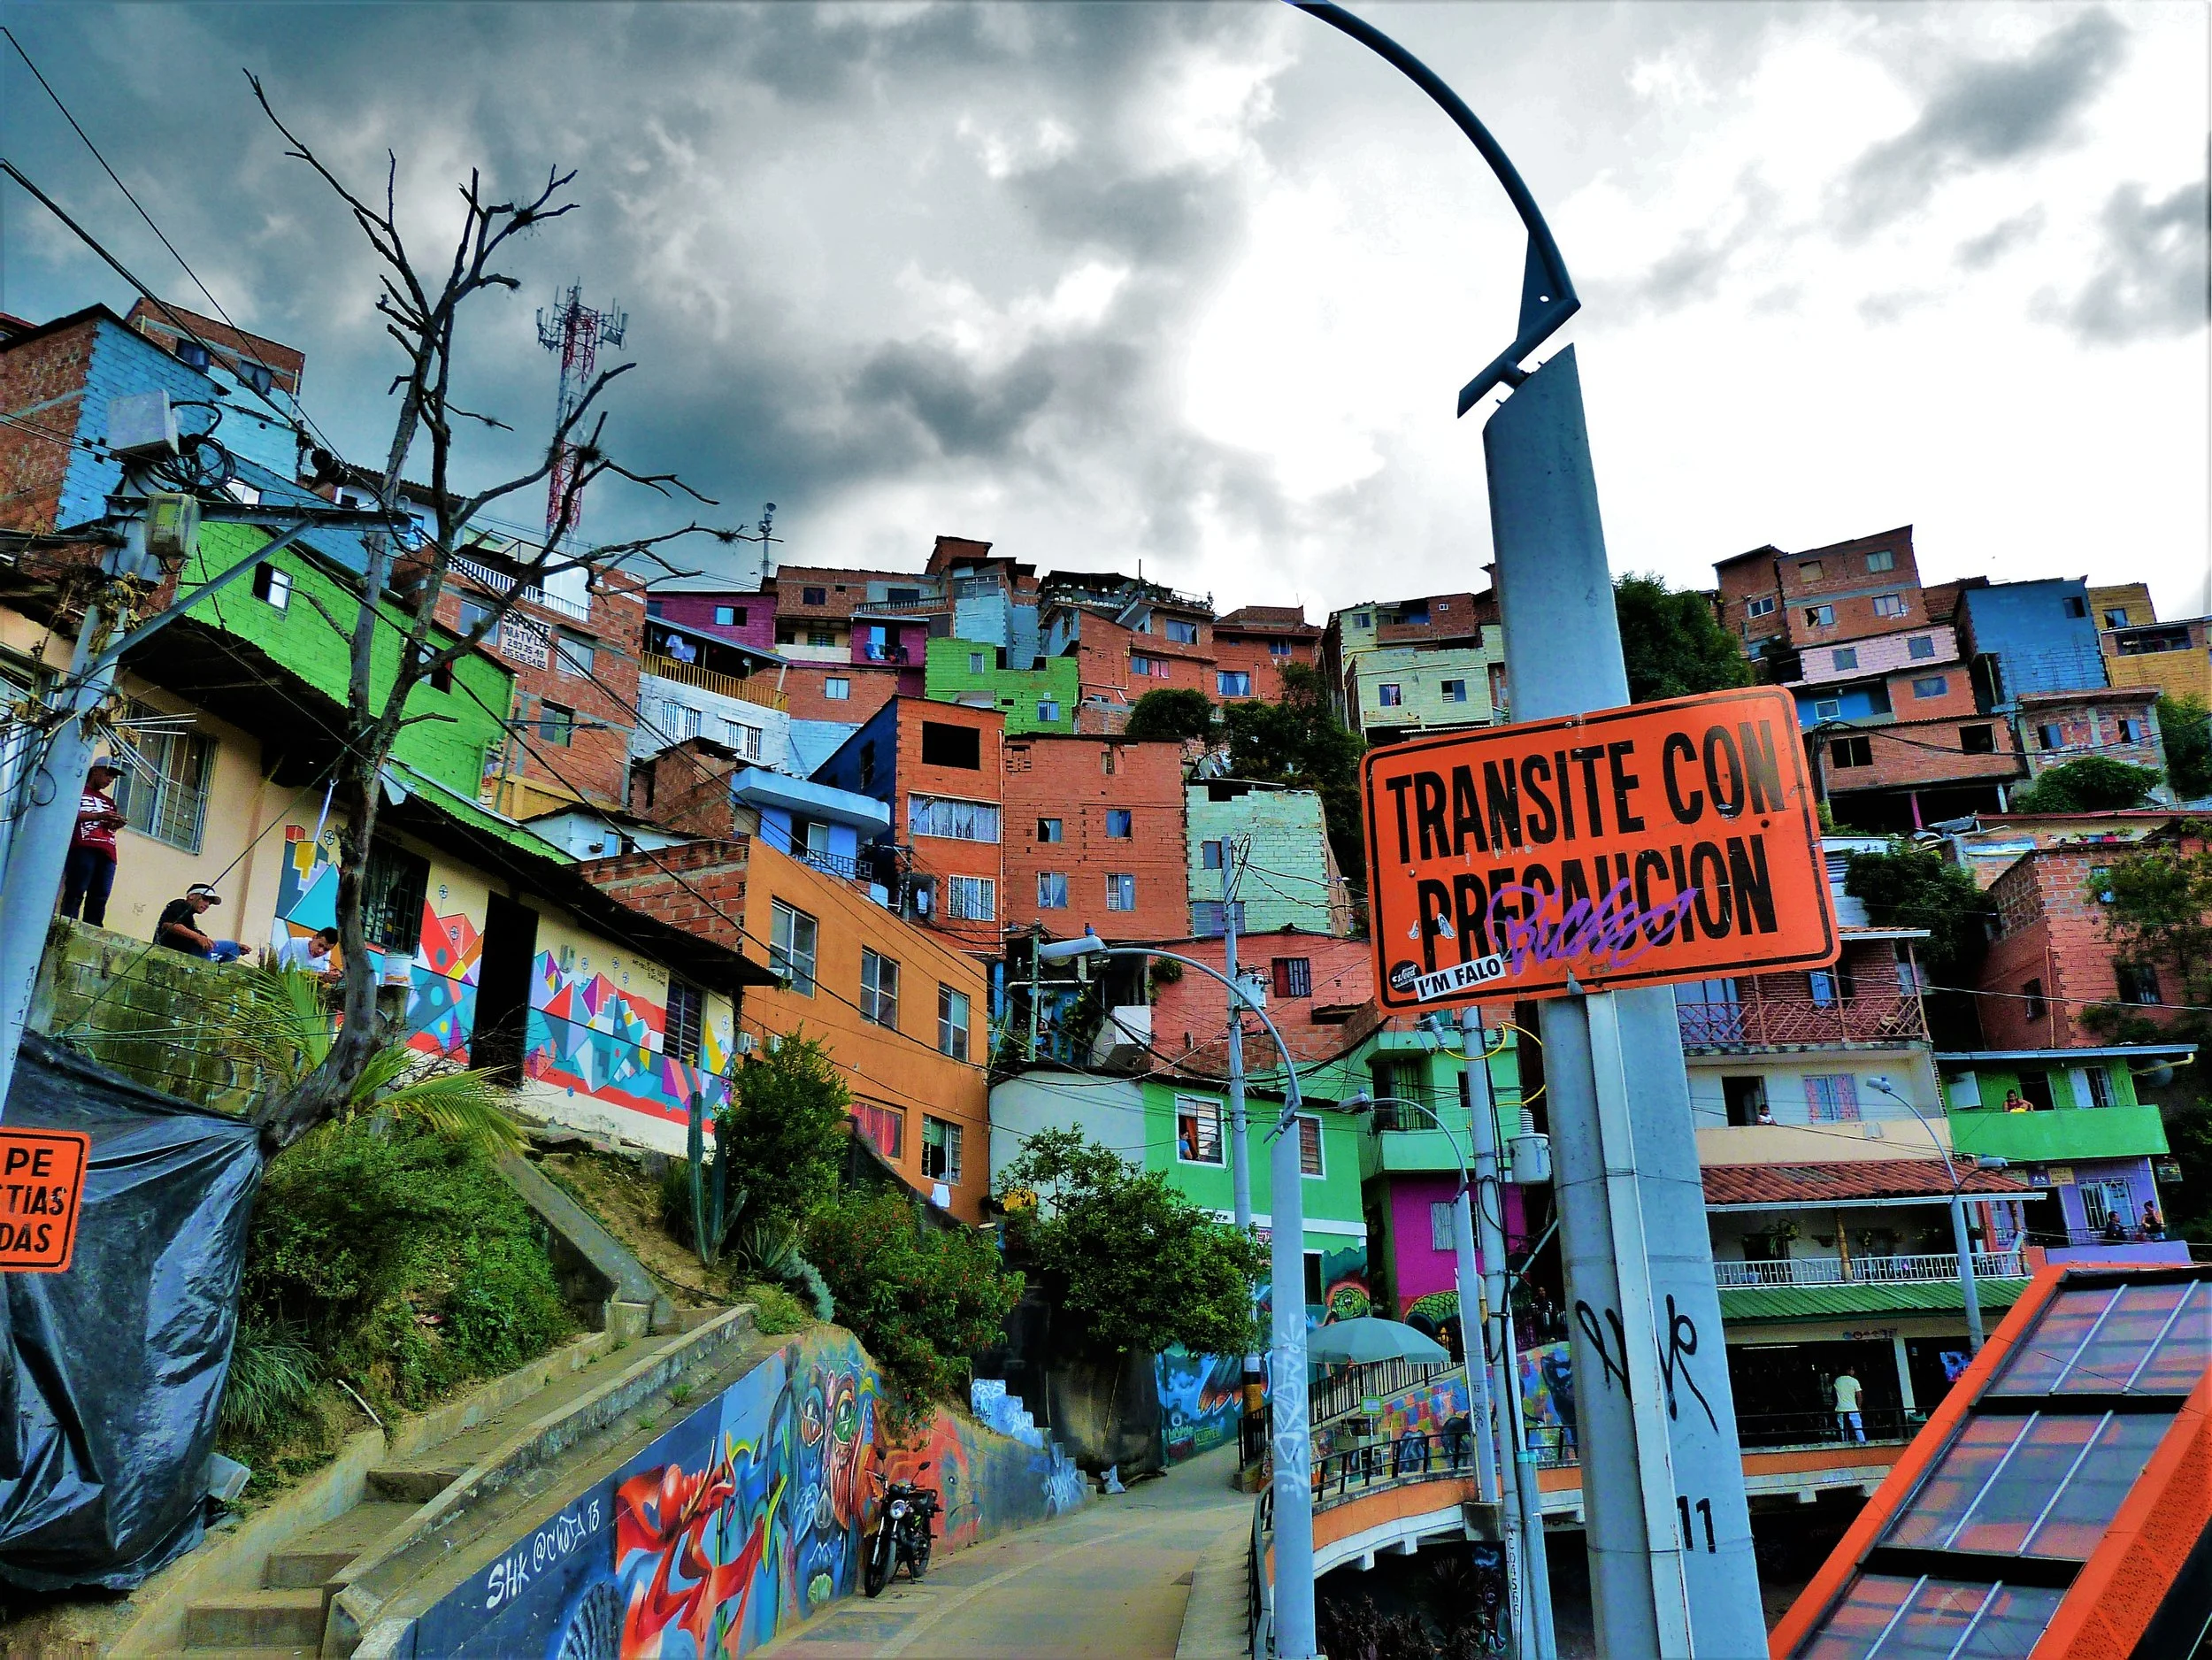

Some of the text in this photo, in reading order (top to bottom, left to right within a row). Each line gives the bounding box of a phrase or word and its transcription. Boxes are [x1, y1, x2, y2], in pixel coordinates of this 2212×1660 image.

[1386, 719, 1786, 865] TRANSITE CON
[1417, 834, 1778, 973] PRECAUCION
[1417, 972, 1451, 997] I'M
[1454, 958, 1502, 987] FALO
[4, 1148, 54, 1178] PE
[0, 1184, 67, 1216] TIAS
[0, 1223, 52, 1254] DAS
[1676, 1495, 1717, 1555] 11
[486, 1551, 530, 1610] SHK
